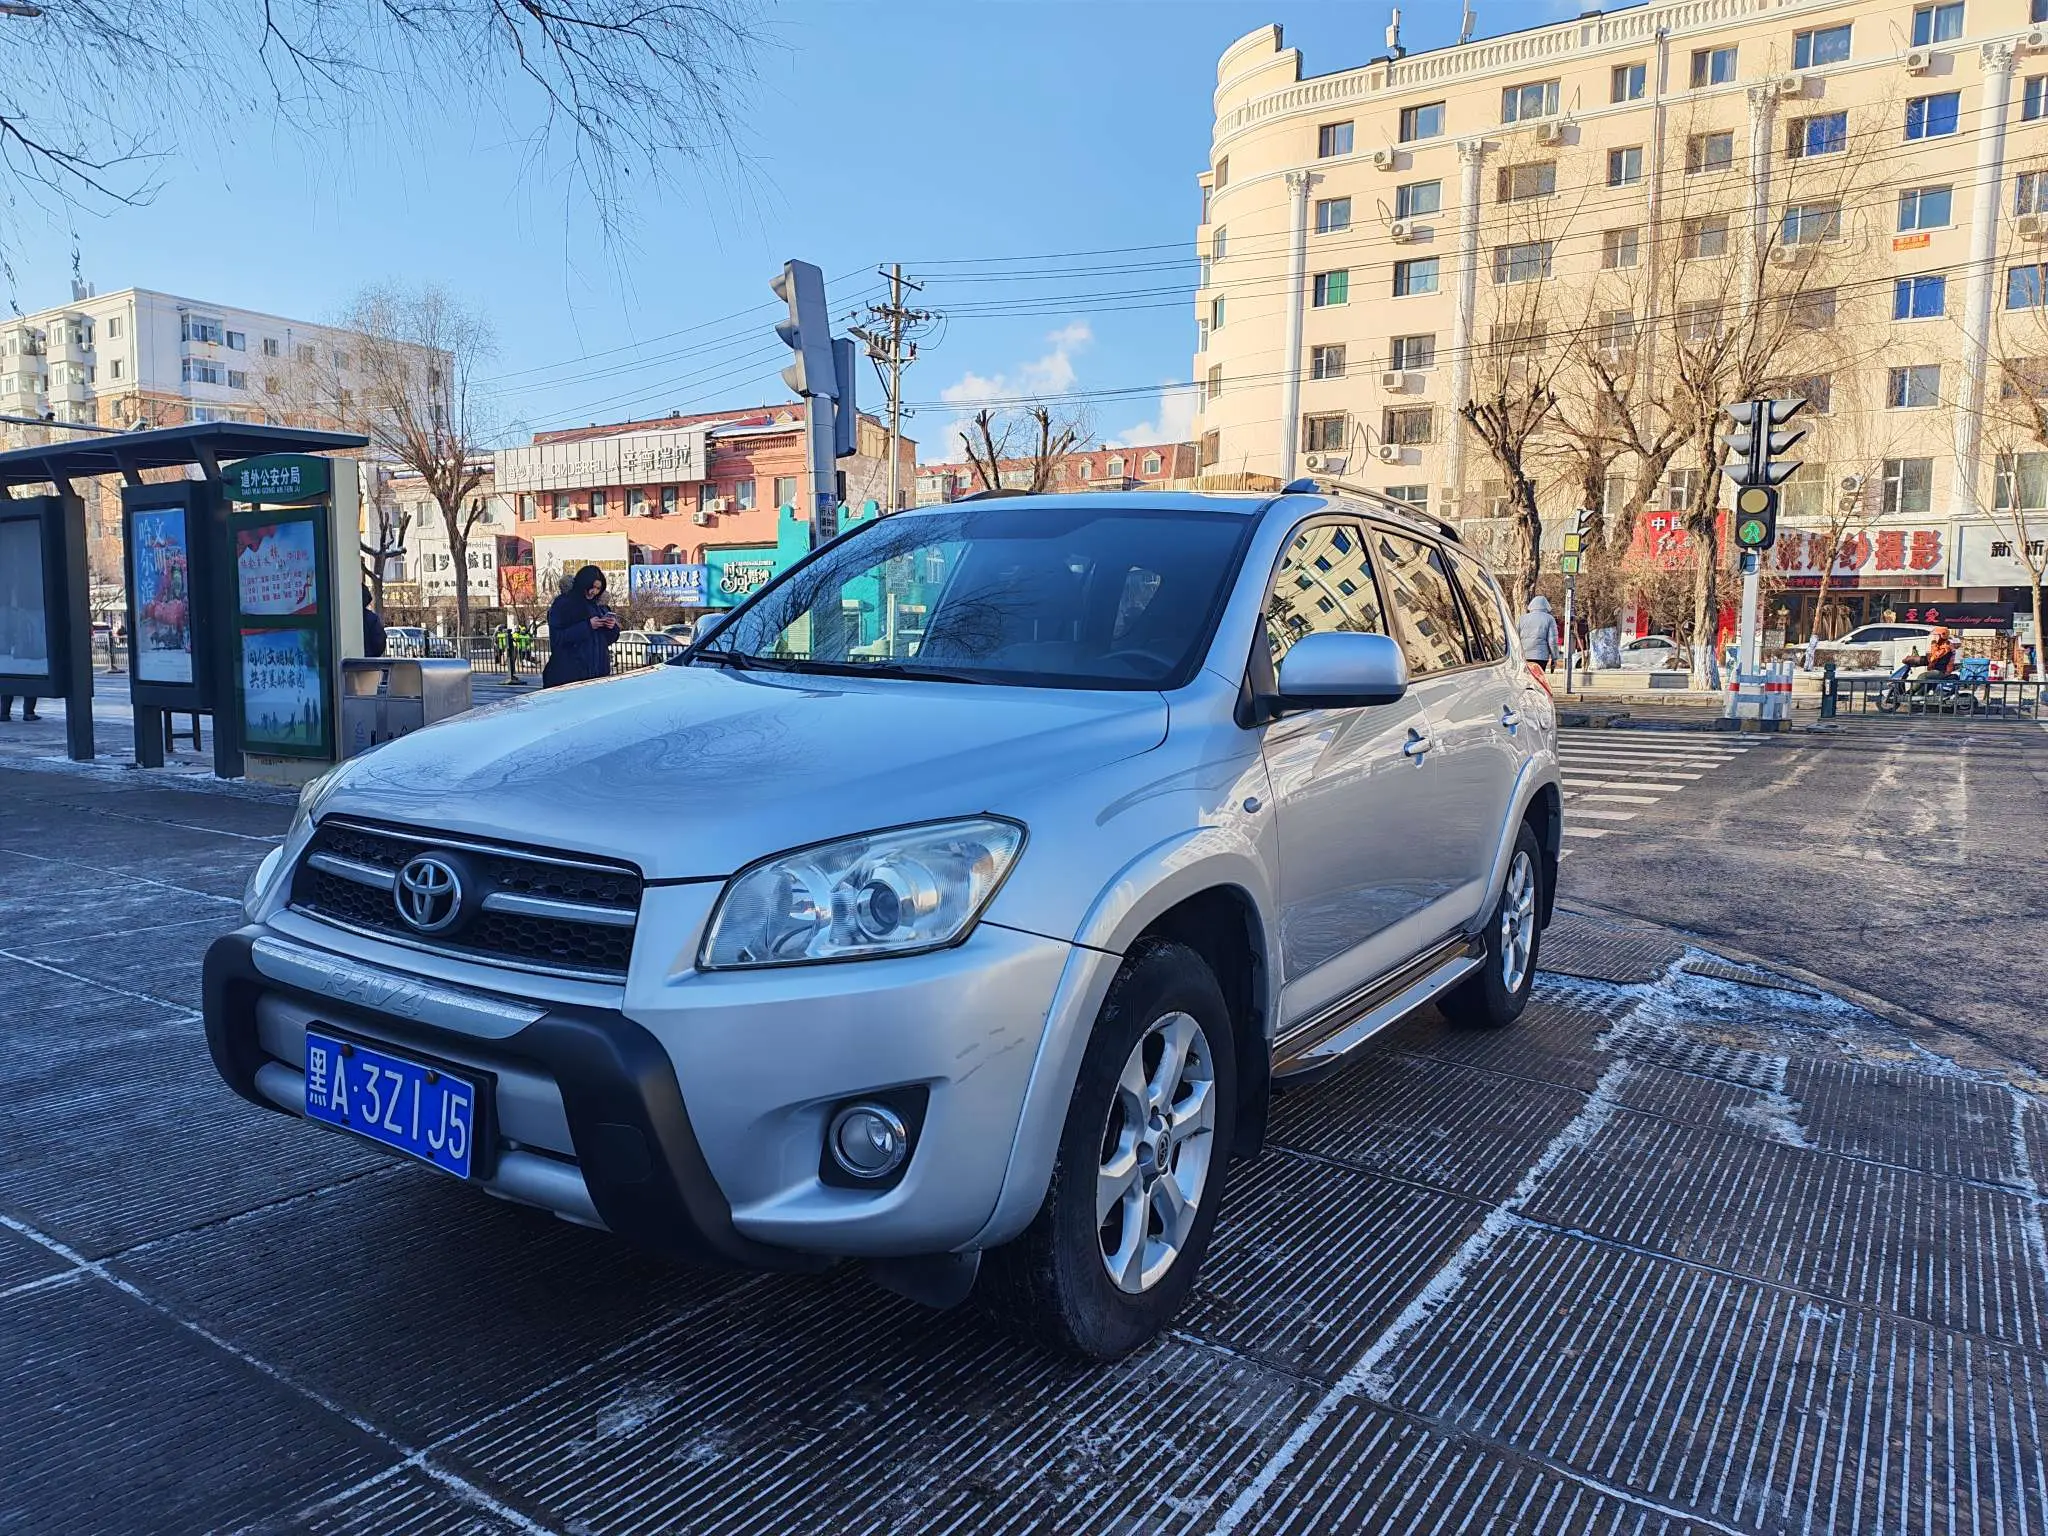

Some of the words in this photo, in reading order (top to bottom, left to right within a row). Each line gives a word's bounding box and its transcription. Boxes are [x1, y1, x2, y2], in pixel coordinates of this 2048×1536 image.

[623, 444, 690, 471] 辛德瑞拉
[241, 466, 300, 488] 道外公安分局
[320, 966, 429, 1018] RAV4
